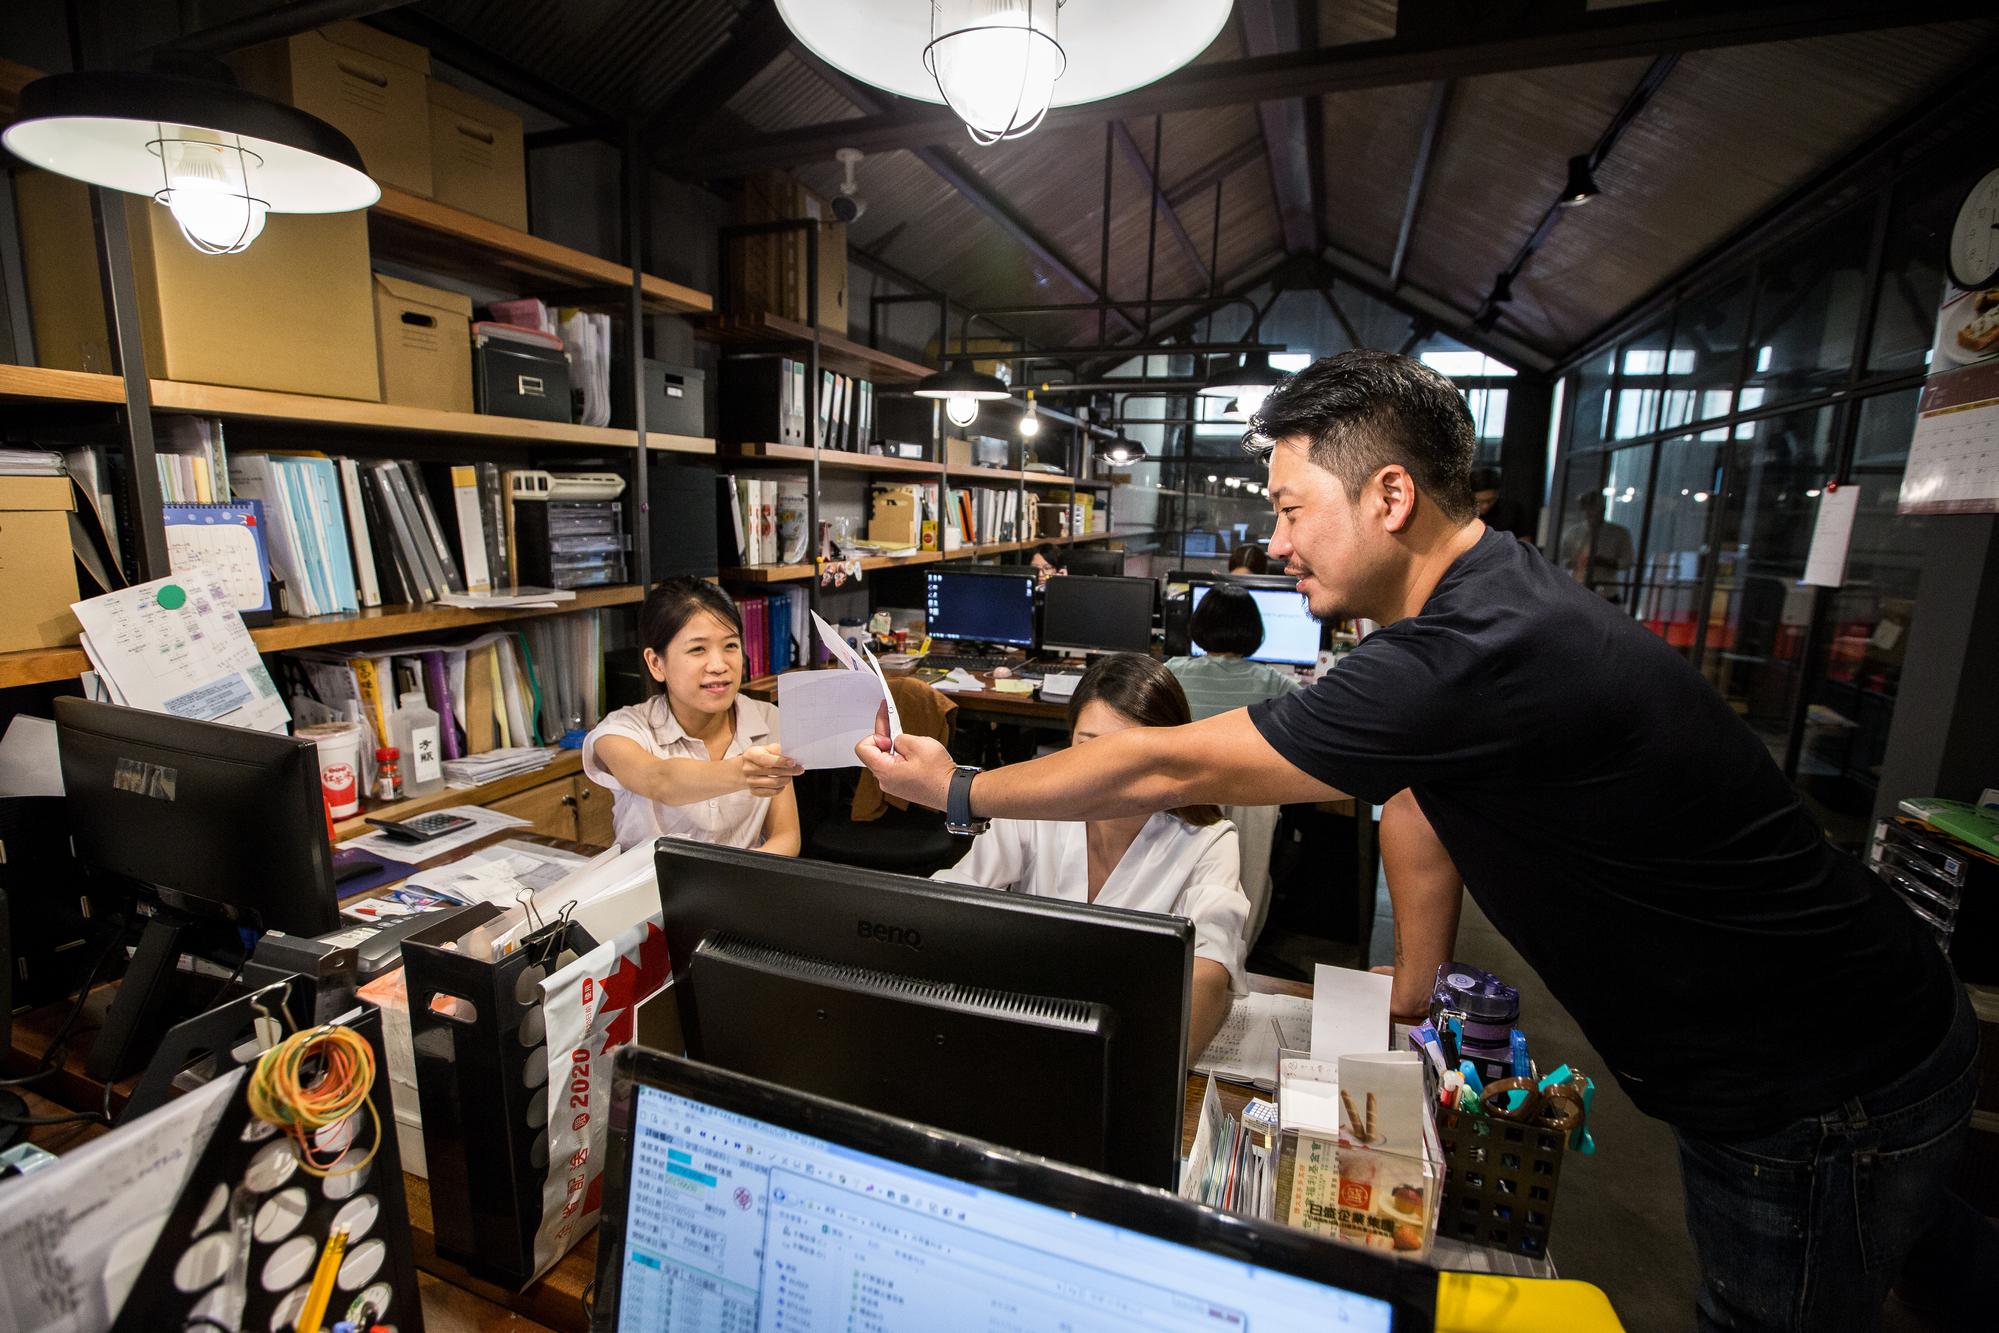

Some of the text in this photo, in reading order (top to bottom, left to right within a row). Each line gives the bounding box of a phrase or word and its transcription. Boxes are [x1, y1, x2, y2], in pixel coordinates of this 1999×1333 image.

[857, 920, 924, 951] BenQ
[570, 1048, 591, 1109] 2020
[1309, 1203, 1396, 1233] 日盛企業集團
